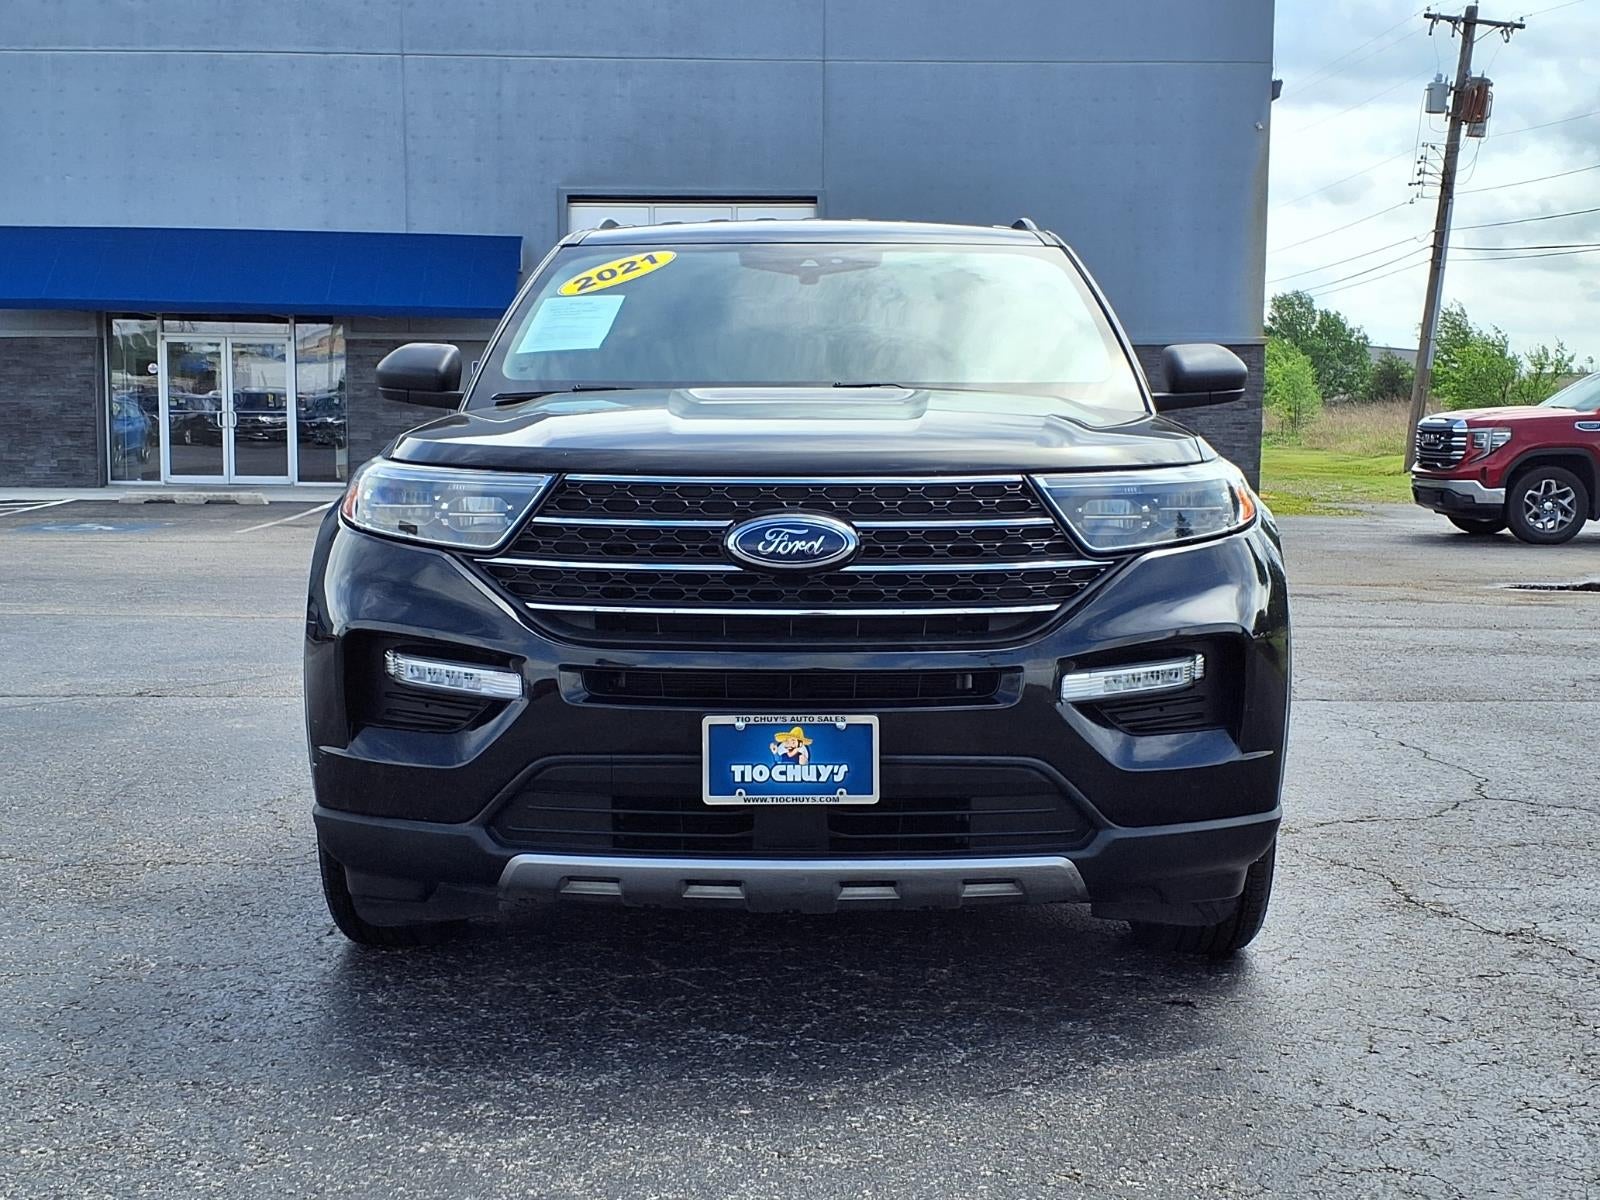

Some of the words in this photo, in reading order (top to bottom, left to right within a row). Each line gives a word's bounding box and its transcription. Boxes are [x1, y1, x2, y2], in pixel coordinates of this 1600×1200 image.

[573, 254, 659, 292] 2021
[757, 527, 825, 555] Ford
[817, 715, 846, 723] SALES
[743, 796, 840, 804] WWW.TIOCHUYS.COM
